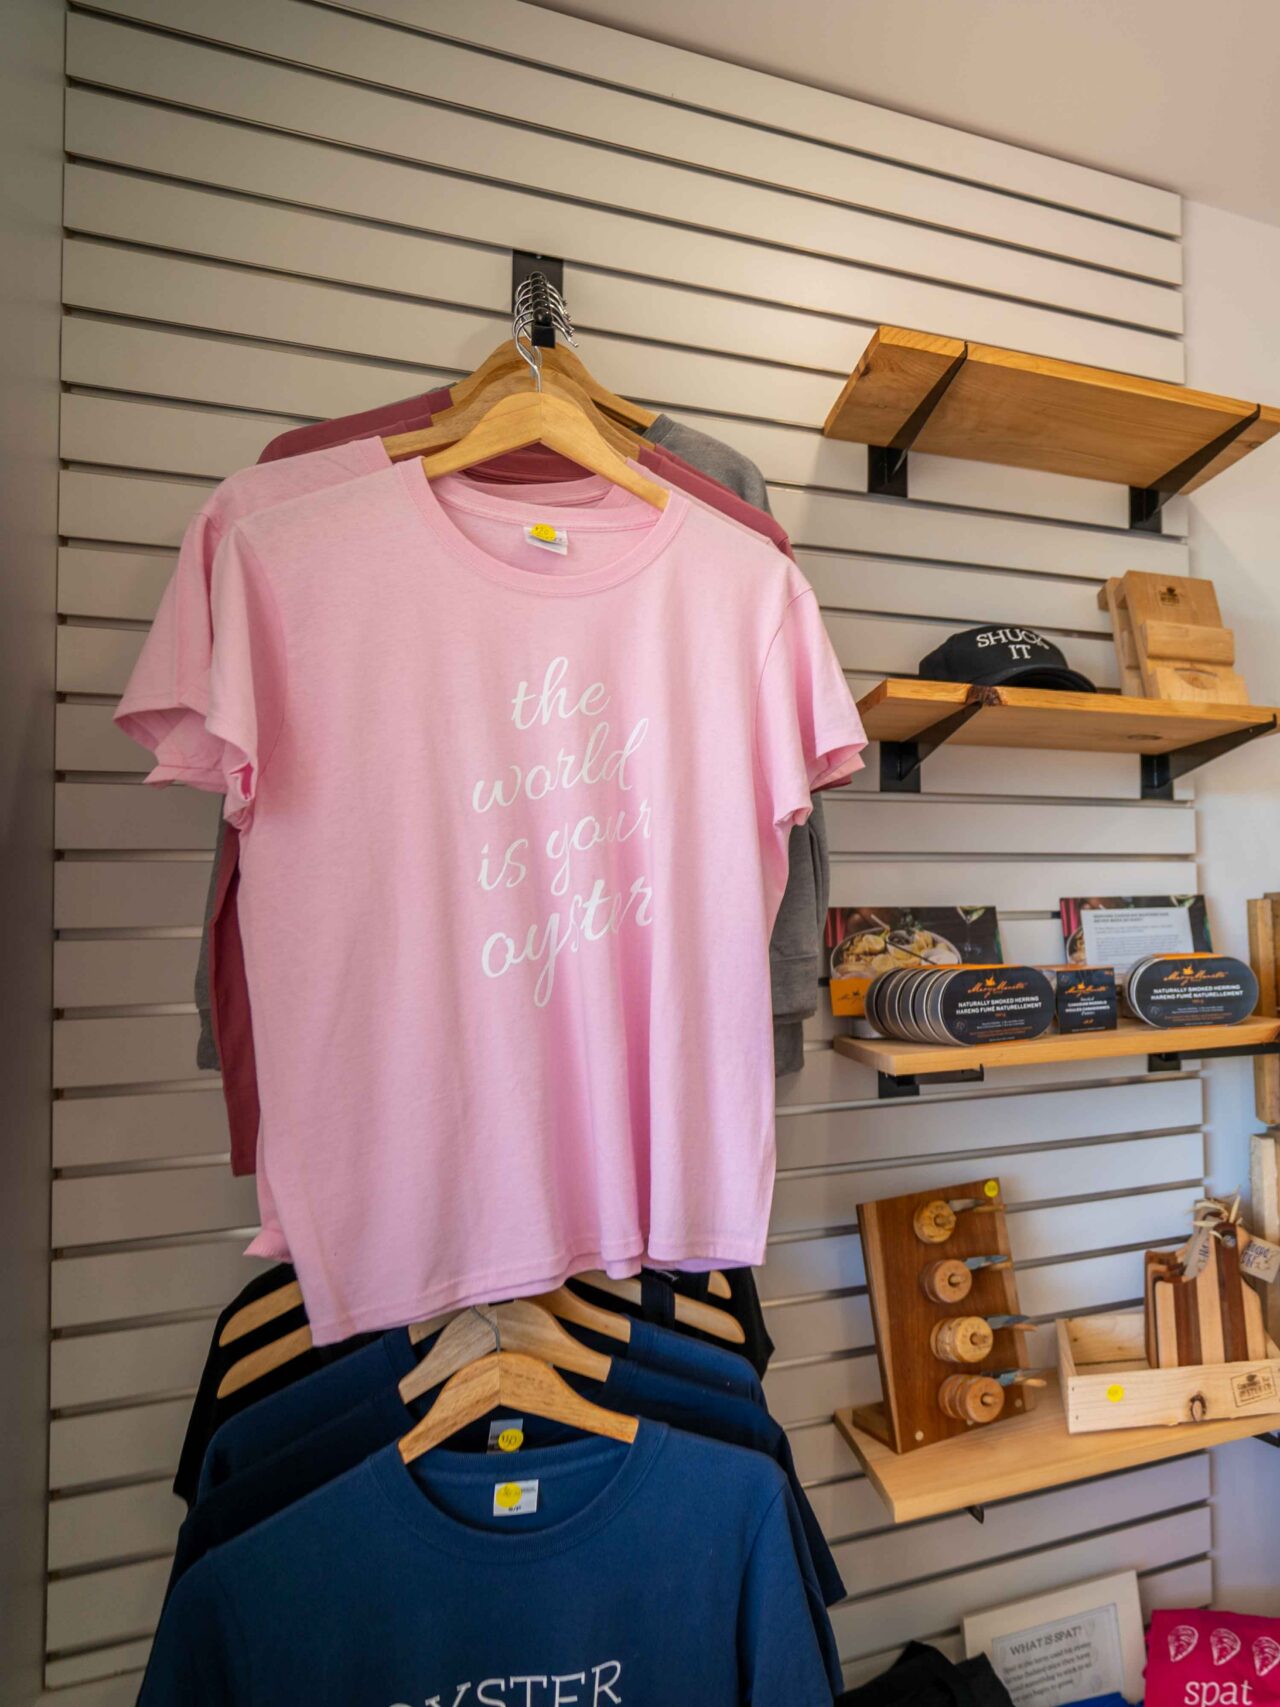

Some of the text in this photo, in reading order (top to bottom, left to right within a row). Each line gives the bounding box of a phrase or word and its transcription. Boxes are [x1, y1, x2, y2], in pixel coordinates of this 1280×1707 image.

[1007, 644, 1032, 660] IT
[511, 655, 612, 730] the
[471, 717, 650, 814] world
[477, 799, 652, 896] is your
[958, 995, 1040, 1008] NATURALLY SMOKED HERRING
[1009, 1637, 1043, 1656] WHAT
[389, 1660, 622, 1707] STER
[1184, 1680, 1253, 1707] spat
